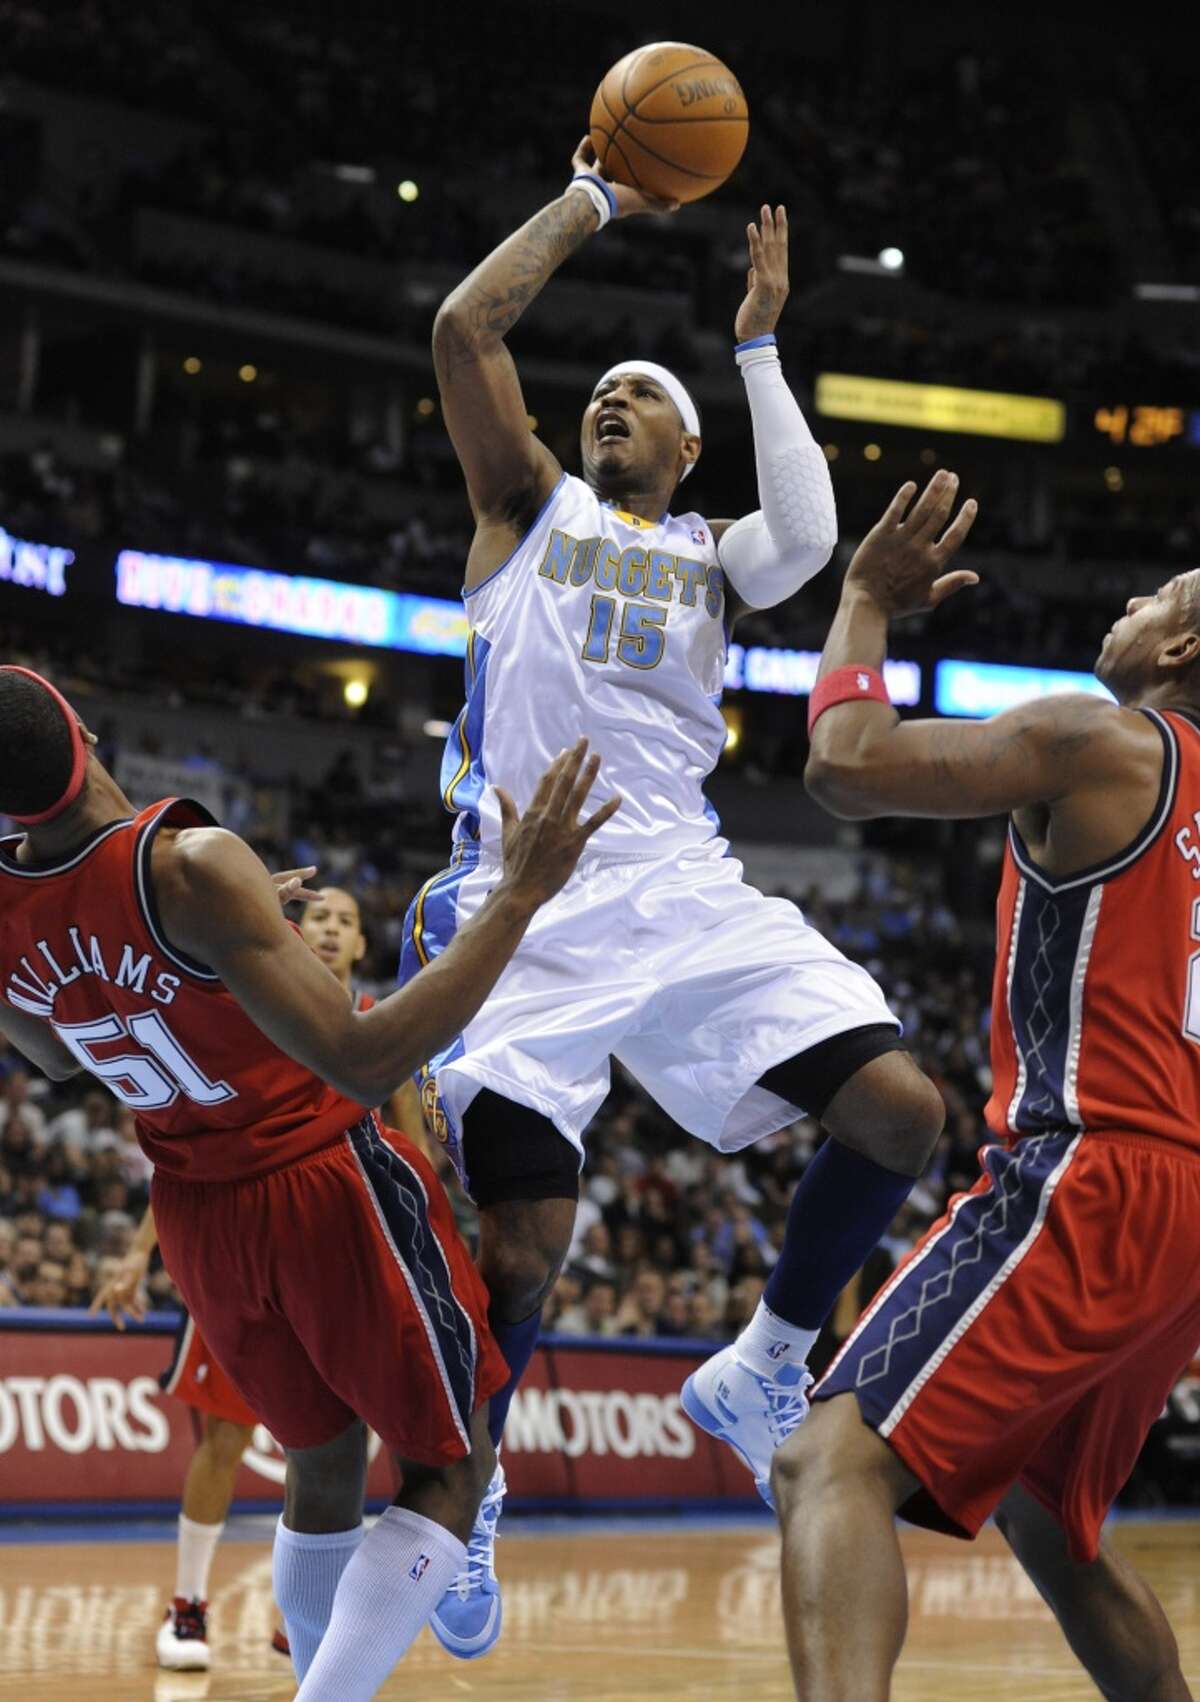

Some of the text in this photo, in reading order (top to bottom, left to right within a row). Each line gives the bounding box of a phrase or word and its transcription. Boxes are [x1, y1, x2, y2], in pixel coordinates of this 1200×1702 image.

[538, 528, 724, 618] NUGGETS
[581, 594, 668, 670] 15
[6, 927, 181, 1016] WILLIAMS
[50, 1008, 239, 1111] 51
[505, 1386, 695, 1459] MOTORS
